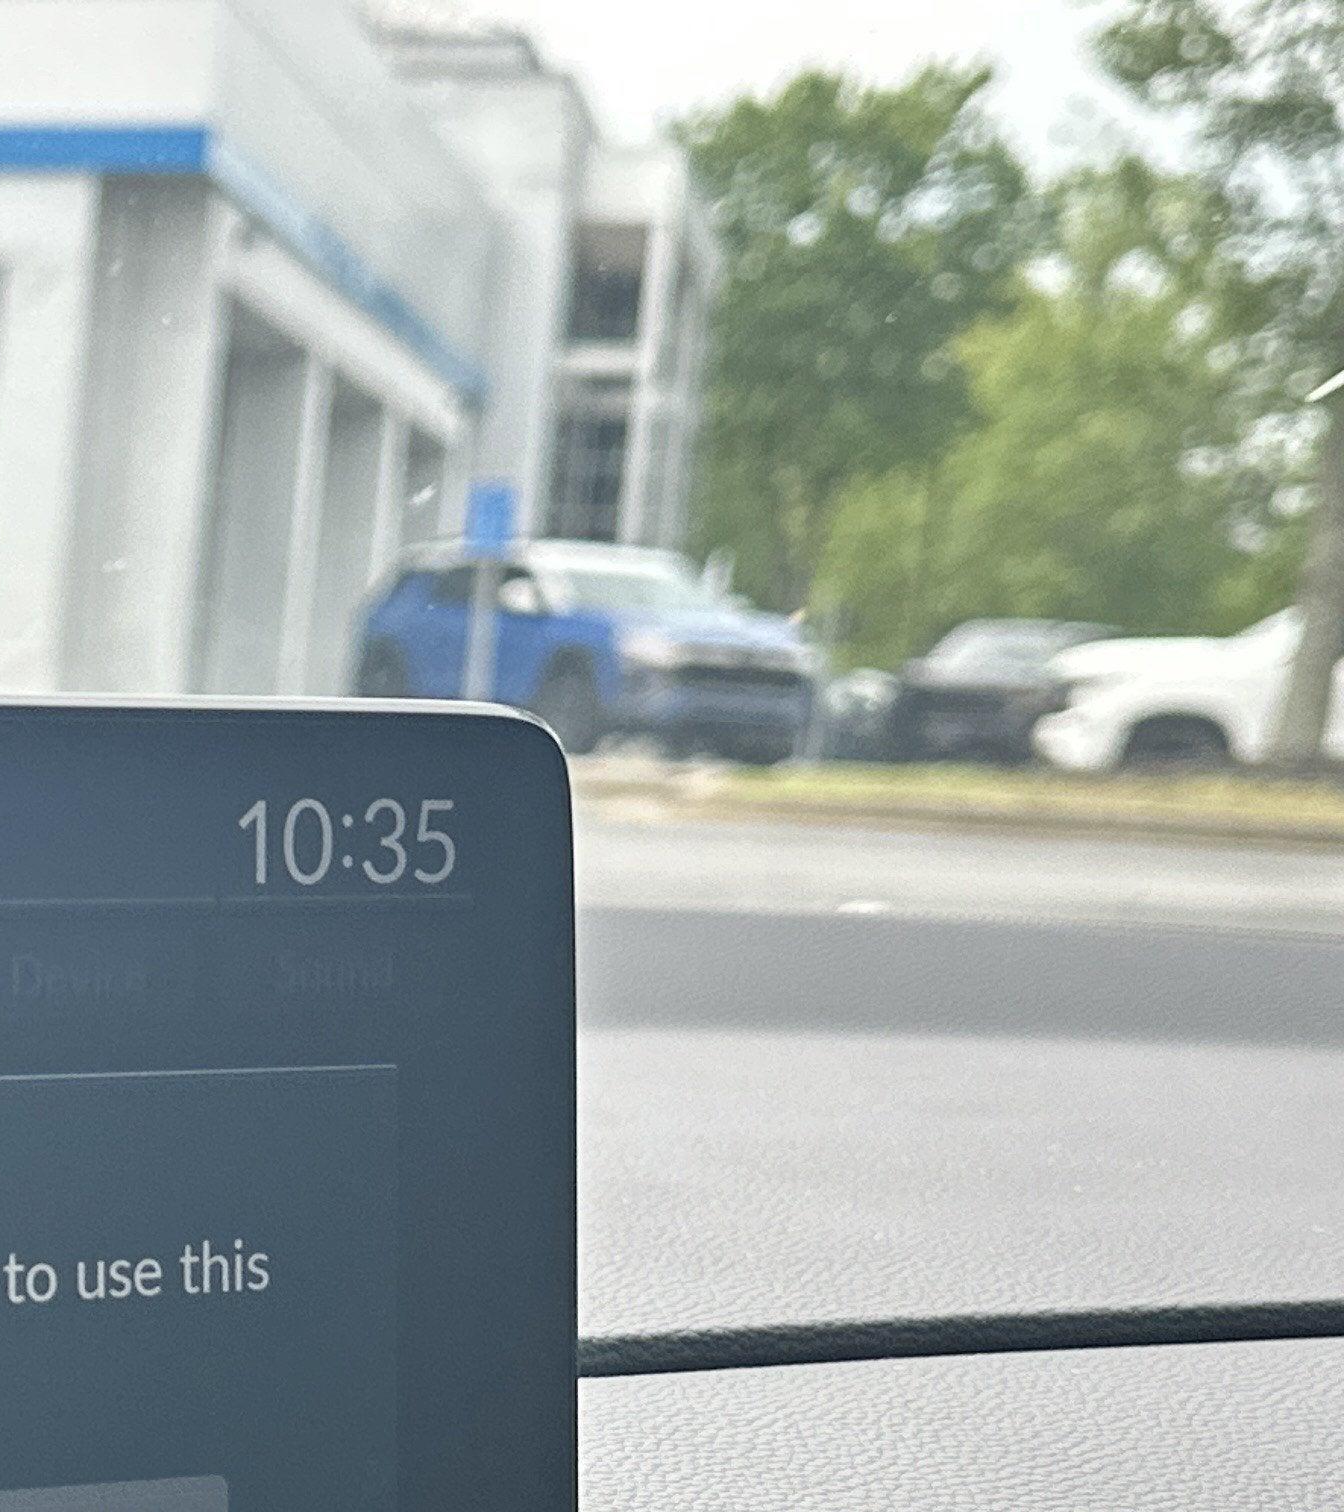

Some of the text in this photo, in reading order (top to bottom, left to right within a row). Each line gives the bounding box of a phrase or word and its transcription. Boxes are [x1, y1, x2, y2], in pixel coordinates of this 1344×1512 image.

[238, 798, 456, 885] 10:35
[3, 1253, 57, 1304] to
[76, 1256, 163, 1300] use
[180, 1239, 270, 1295] this
